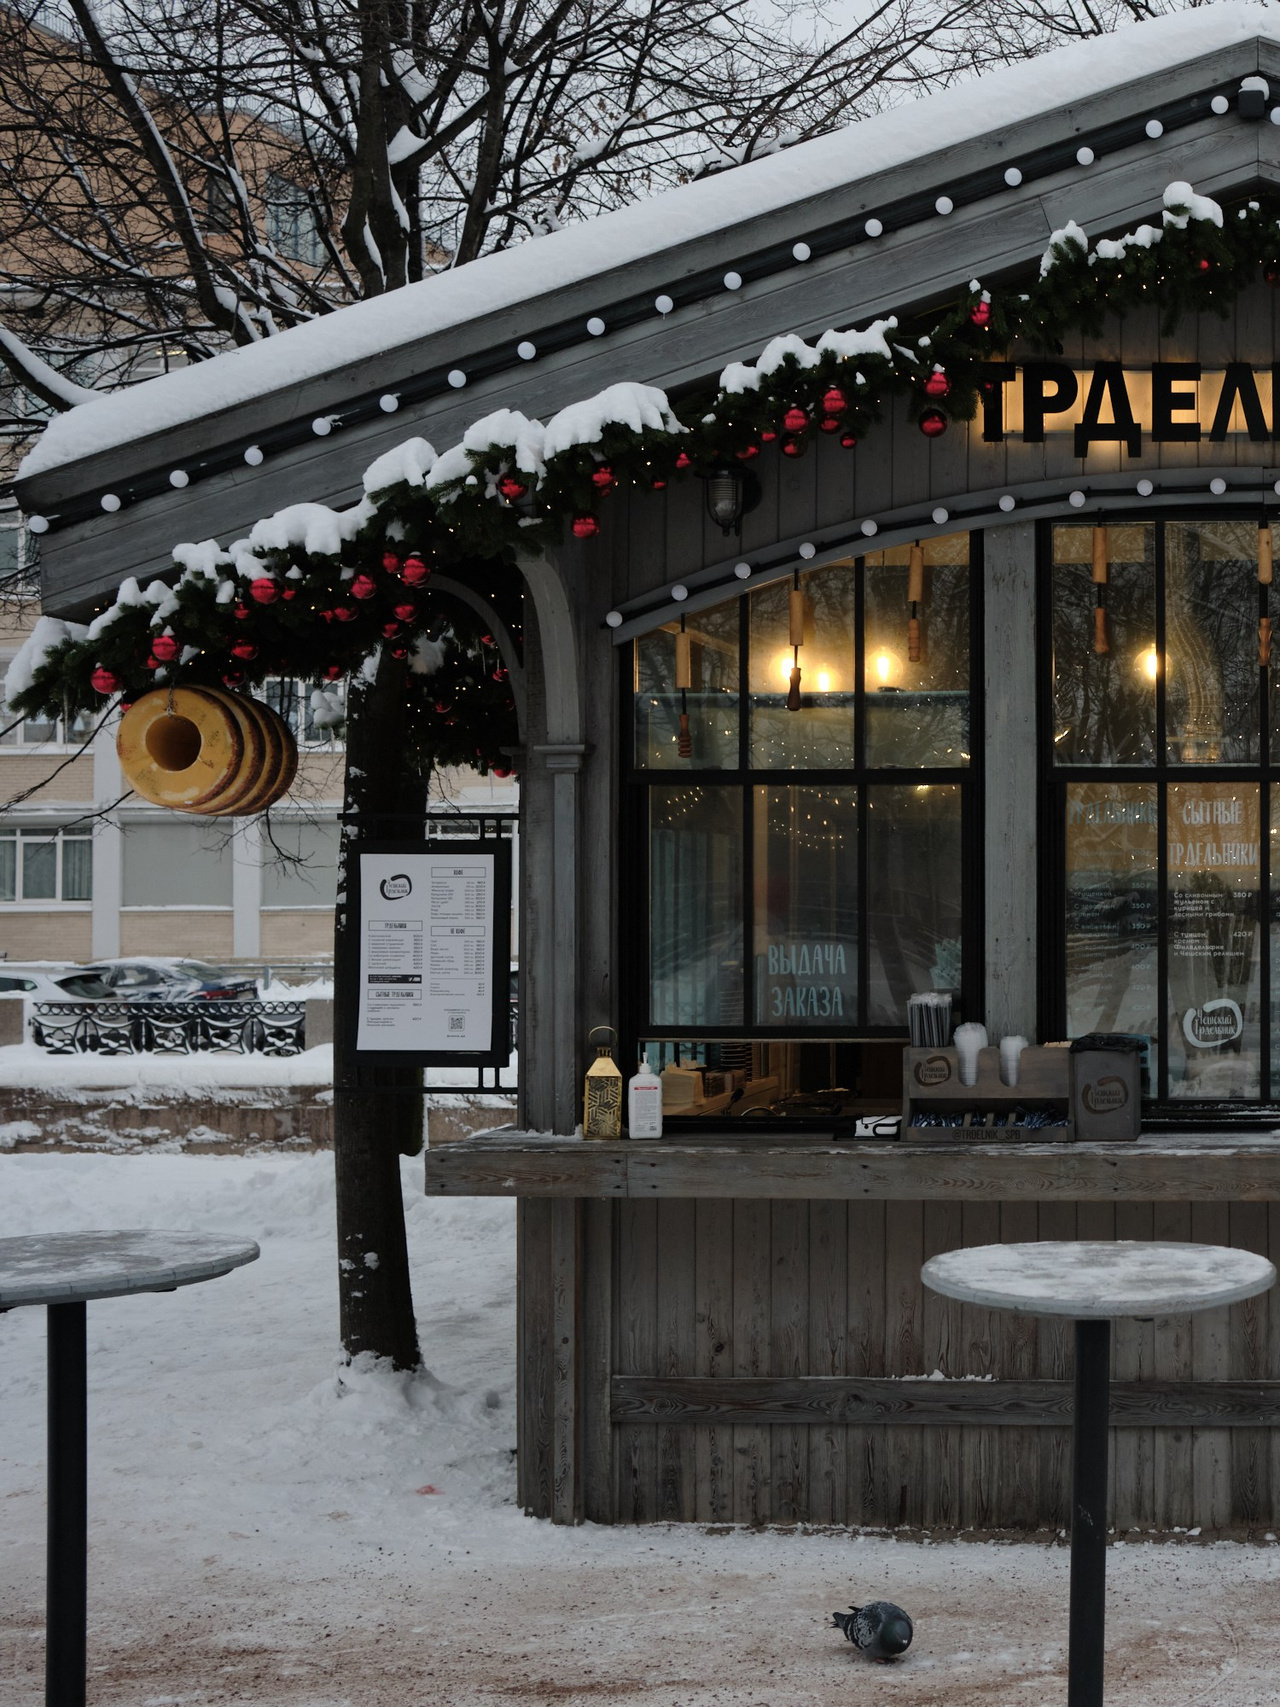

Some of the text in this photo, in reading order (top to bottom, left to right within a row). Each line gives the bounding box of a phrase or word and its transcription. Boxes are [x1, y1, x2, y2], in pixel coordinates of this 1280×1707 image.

[1182, 800, 1244, 825] СЫТНЫЕ
[1168, 842, 1259, 866] ТРДЕЛЬНИКИ
[767, 943, 847, 976] ВЫДАЧА
[771, 985, 844, 1018] ЗАКАЗА
[1197, 1009, 1232, 1025] Чешский
[1194, 1018, 1236, 1041] Трдельник
